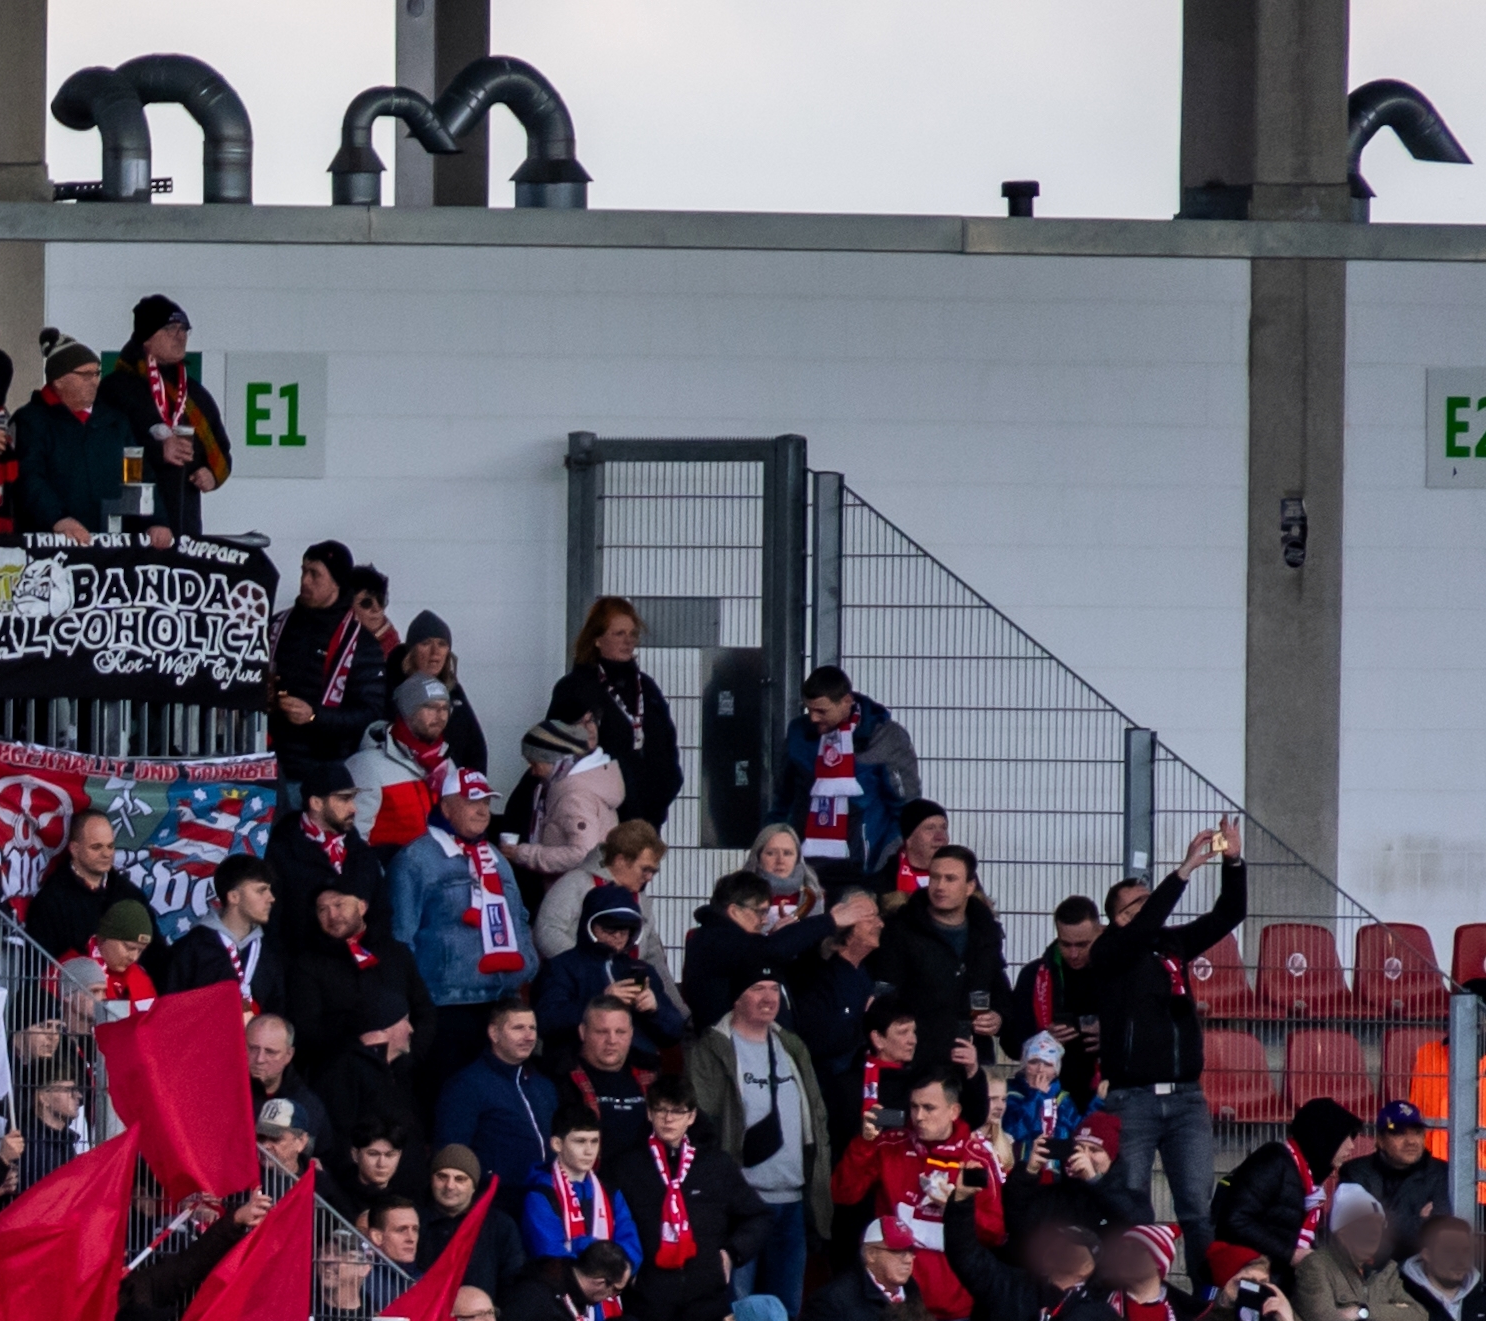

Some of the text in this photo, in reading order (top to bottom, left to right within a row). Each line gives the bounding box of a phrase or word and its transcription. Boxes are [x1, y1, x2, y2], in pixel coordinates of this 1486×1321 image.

[245, 382, 307, 446] E1
[178, 535, 250, 565] SUPPORT
[69, 564, 231, 614] BANDA
[133, 760, 180, 783] UND
